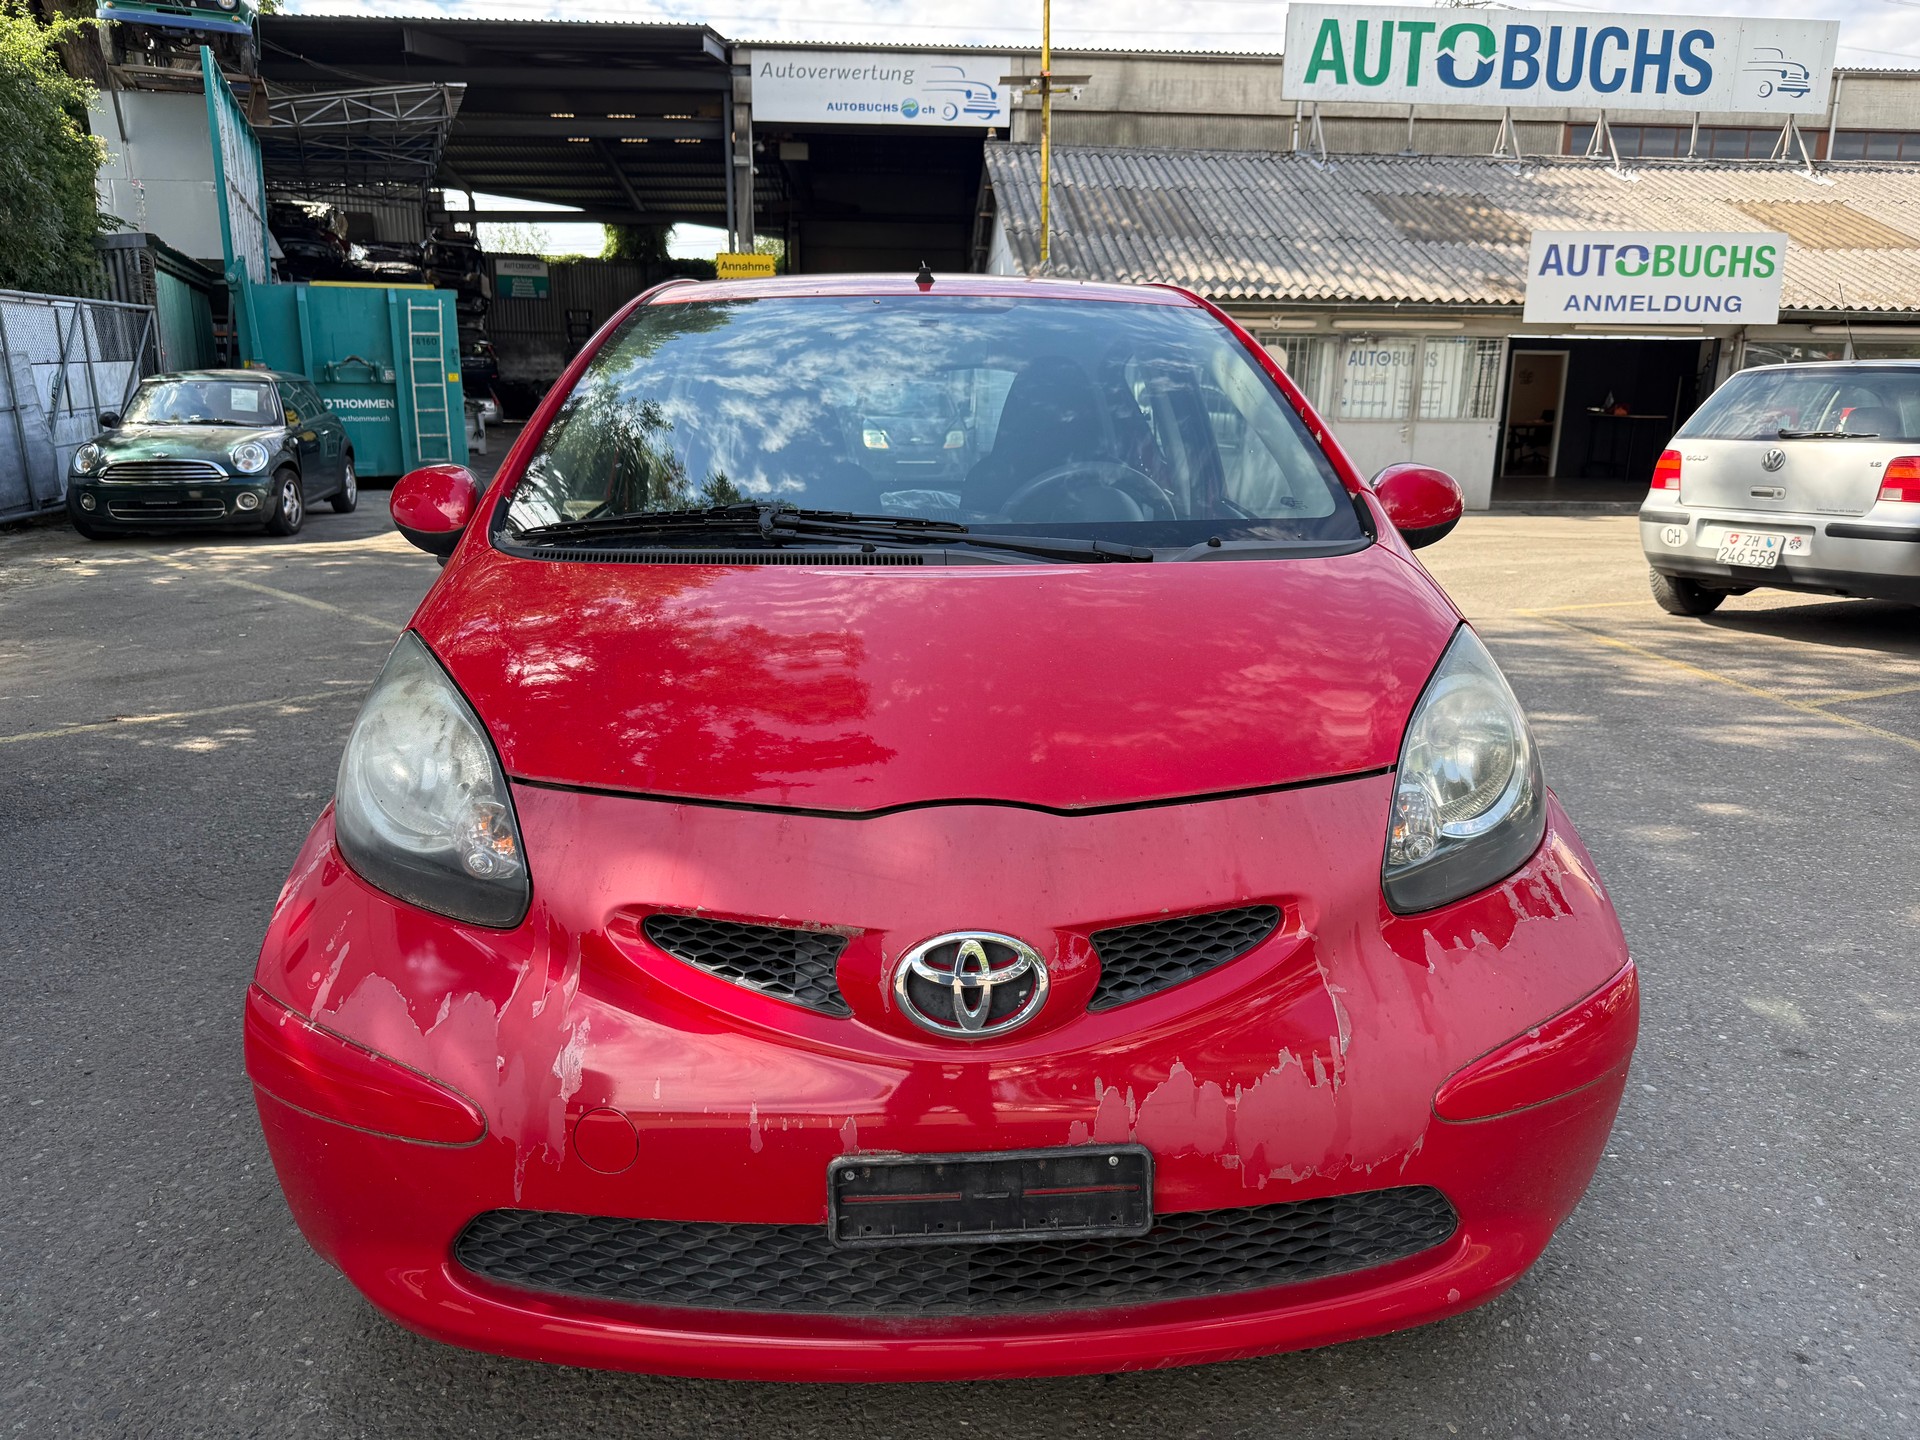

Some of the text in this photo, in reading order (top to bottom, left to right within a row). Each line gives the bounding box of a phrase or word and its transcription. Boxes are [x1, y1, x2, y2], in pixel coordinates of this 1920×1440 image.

[1303, 18, 1716, 96] AUTOBUCHS
[760, 62, 915, 85] Autoverwertung
[826, 102, 936, 114] AUTOBUCHS ch
[721, 261, 771, 271] Annahme
[1538, 243, 1777, 278] AUTOBUCHS
[1563, 294, 1743, 313] ANMELDUNG
[333, 399, 395, 409] THOMMEN
[1666, 529, 1681, 544] CH
[1744, 535, 1760, 547] ZH
[1719, 547, 1776, 567] 246 558
